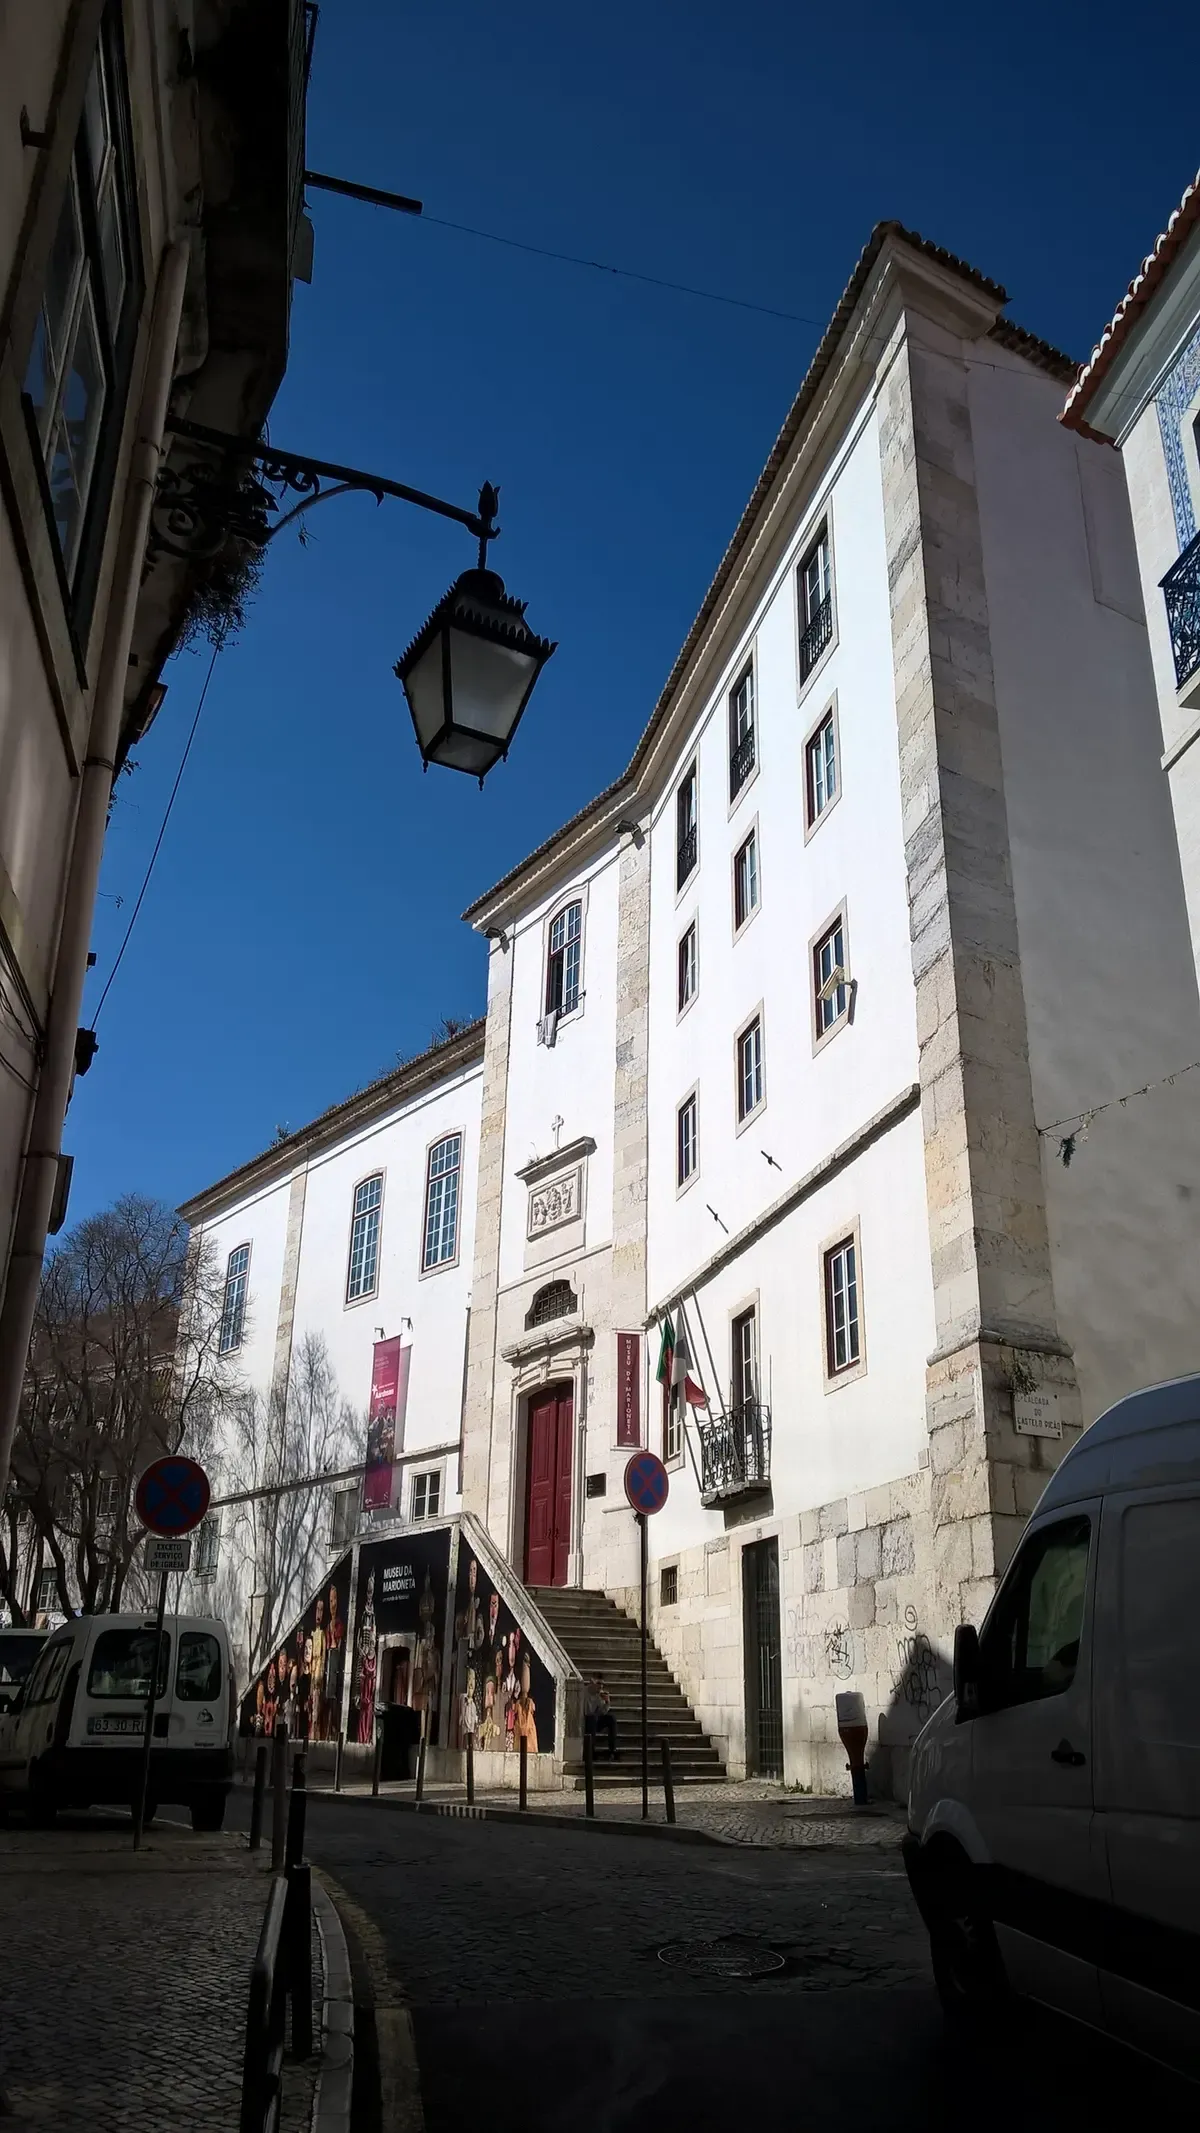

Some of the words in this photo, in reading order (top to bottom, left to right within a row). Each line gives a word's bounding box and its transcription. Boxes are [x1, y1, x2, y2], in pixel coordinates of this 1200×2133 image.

[156, 1543, 182, 1551] EXCETO
[154, 1552, 183, 1560] SERVIÇO
[150, 1560, 159, 1569] DE
[160, 1560, 185, 1569] IGREJA
[383, 1566, 404, 1580] MUSEU
[403, 1564, 413, 1576] DA
[382, 1577, 416, 1593] MARIONETA
